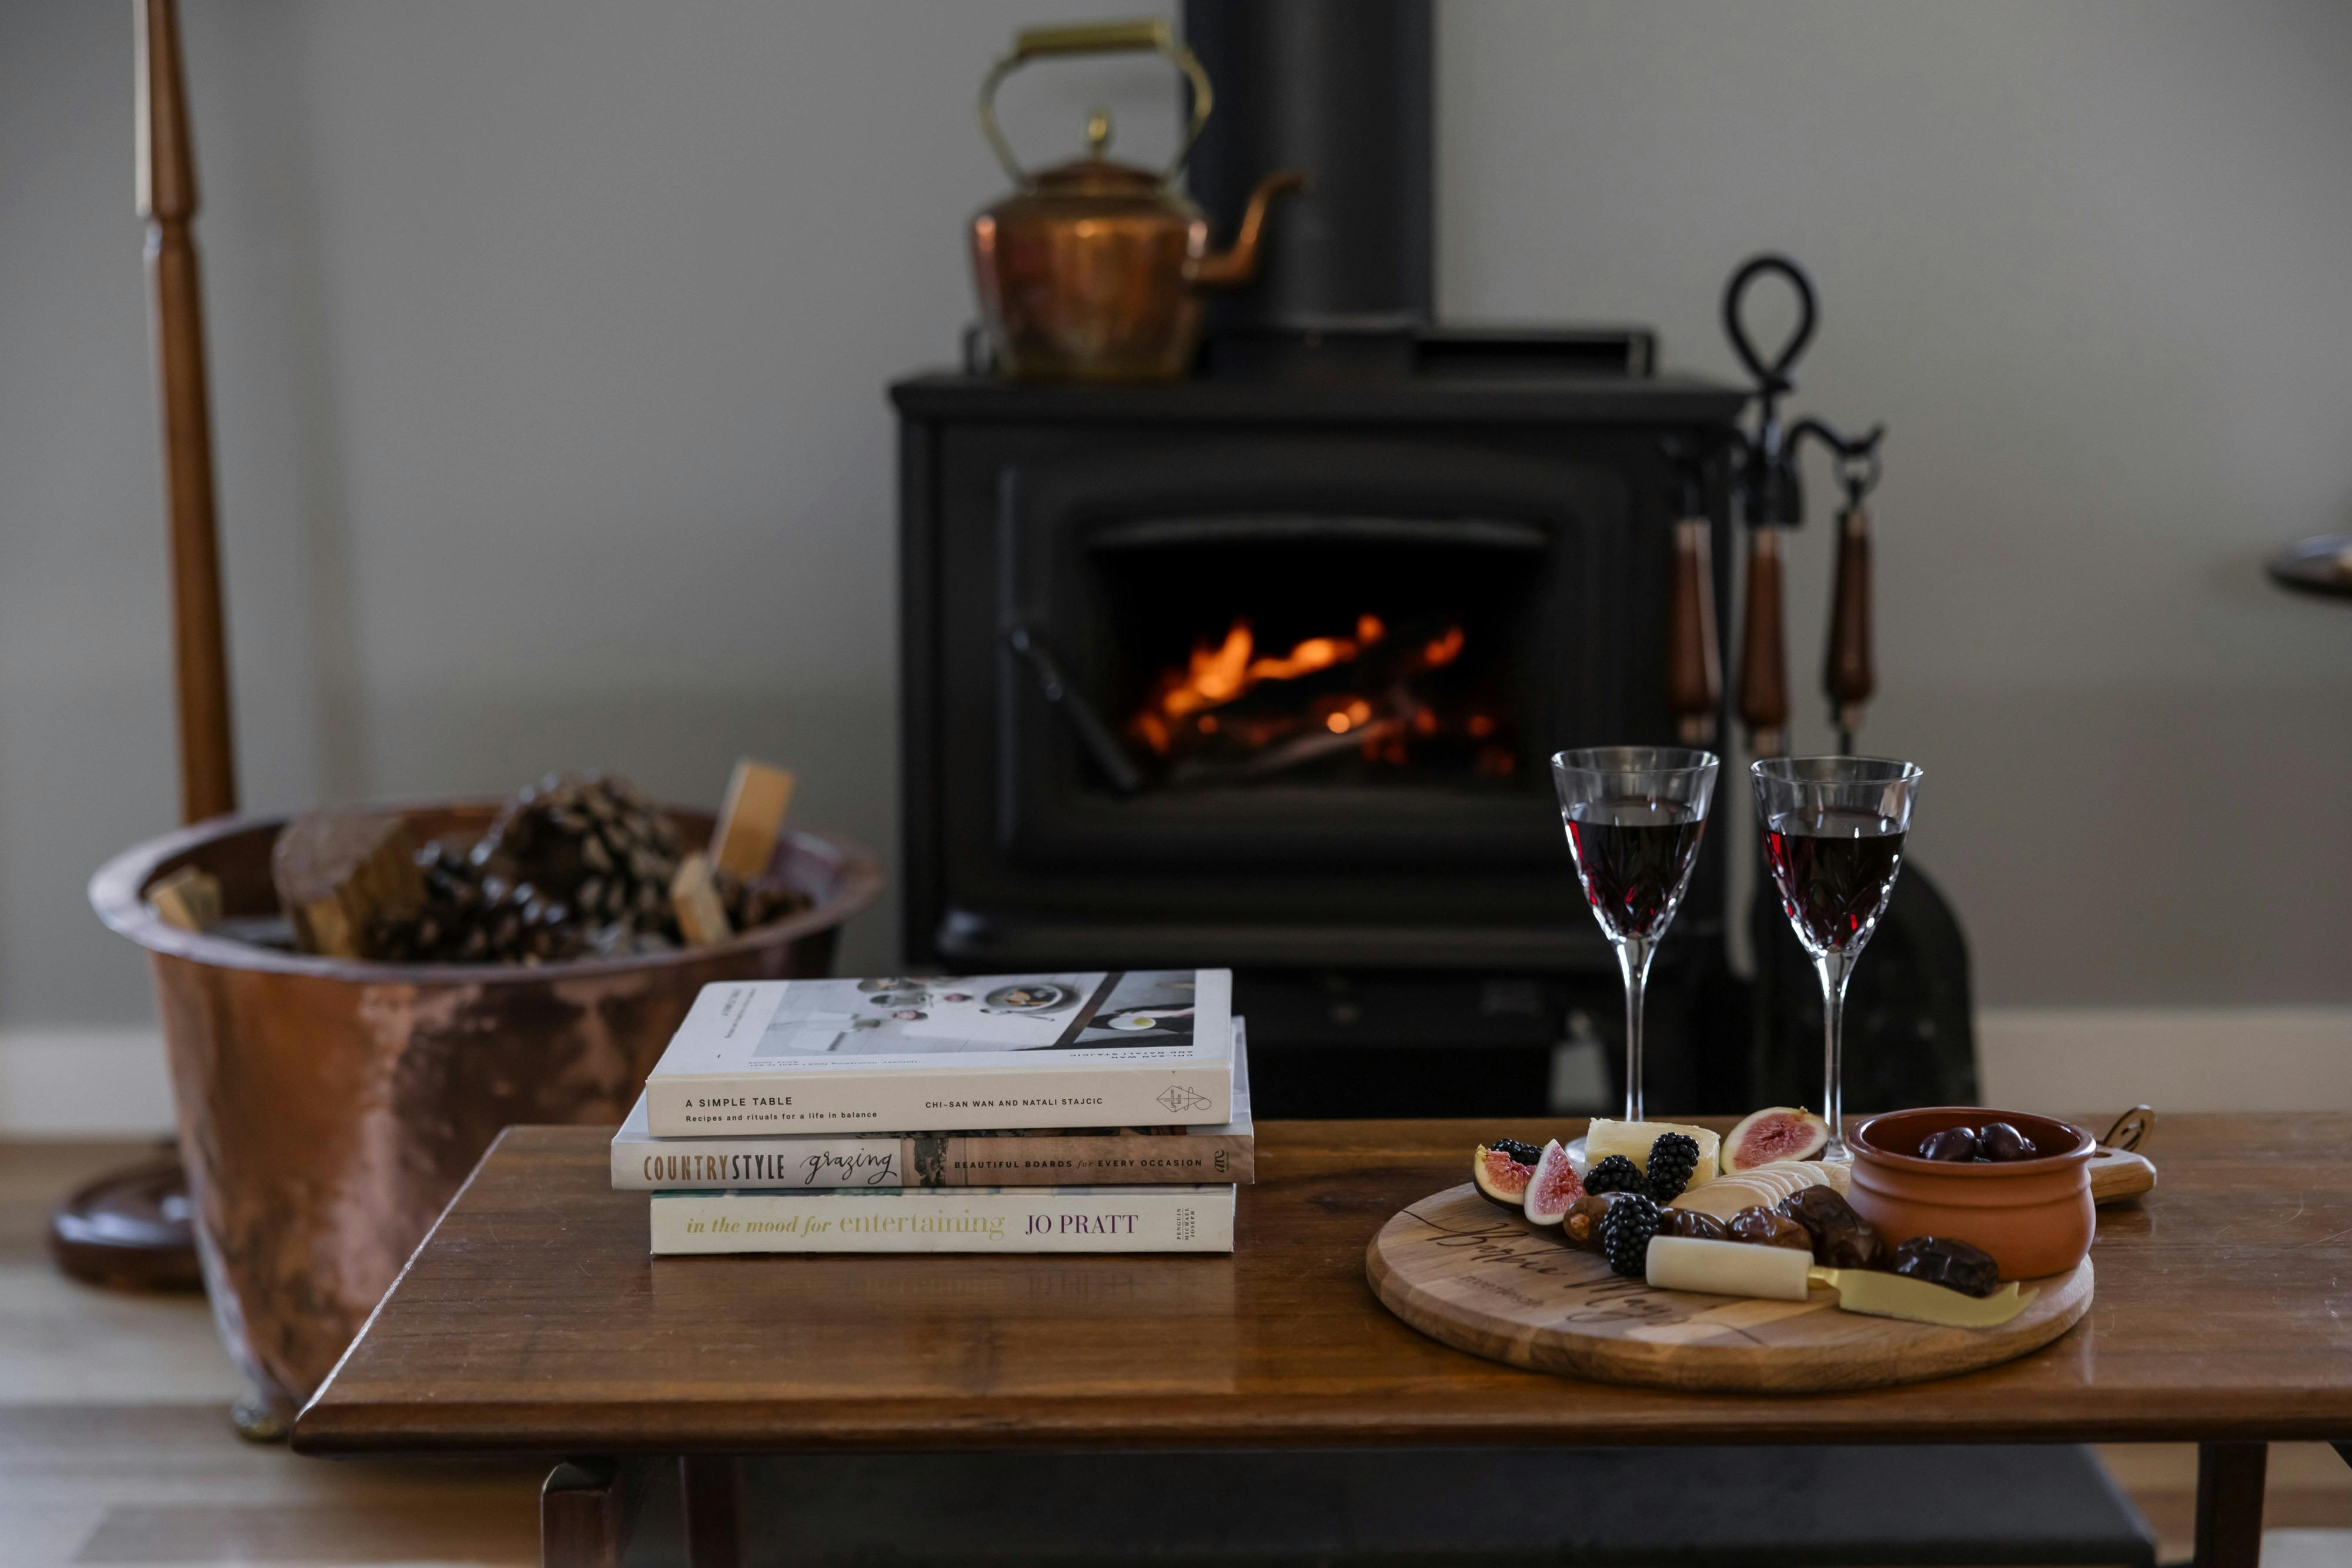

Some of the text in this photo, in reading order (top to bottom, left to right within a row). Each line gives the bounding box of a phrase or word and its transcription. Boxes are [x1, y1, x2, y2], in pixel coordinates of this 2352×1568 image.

[685, 1096, 792, 1108] A SIMPLE TABLE
[686, 1115, 723, 1123] Recipes
[800, 1148, 898, 1185] grazing
[954, 1159, 1202, 1172] BEAUTIFUL BOARDS for EVERY OCCASION
[1214, 1148, 1225, 1173] are
[686, 1209, 1005, 1242] in the mood for entertaining
[1025, 1215, 1138, 1235] JO PRATT
[1408, 1221, 1582, 1276] Barbie
